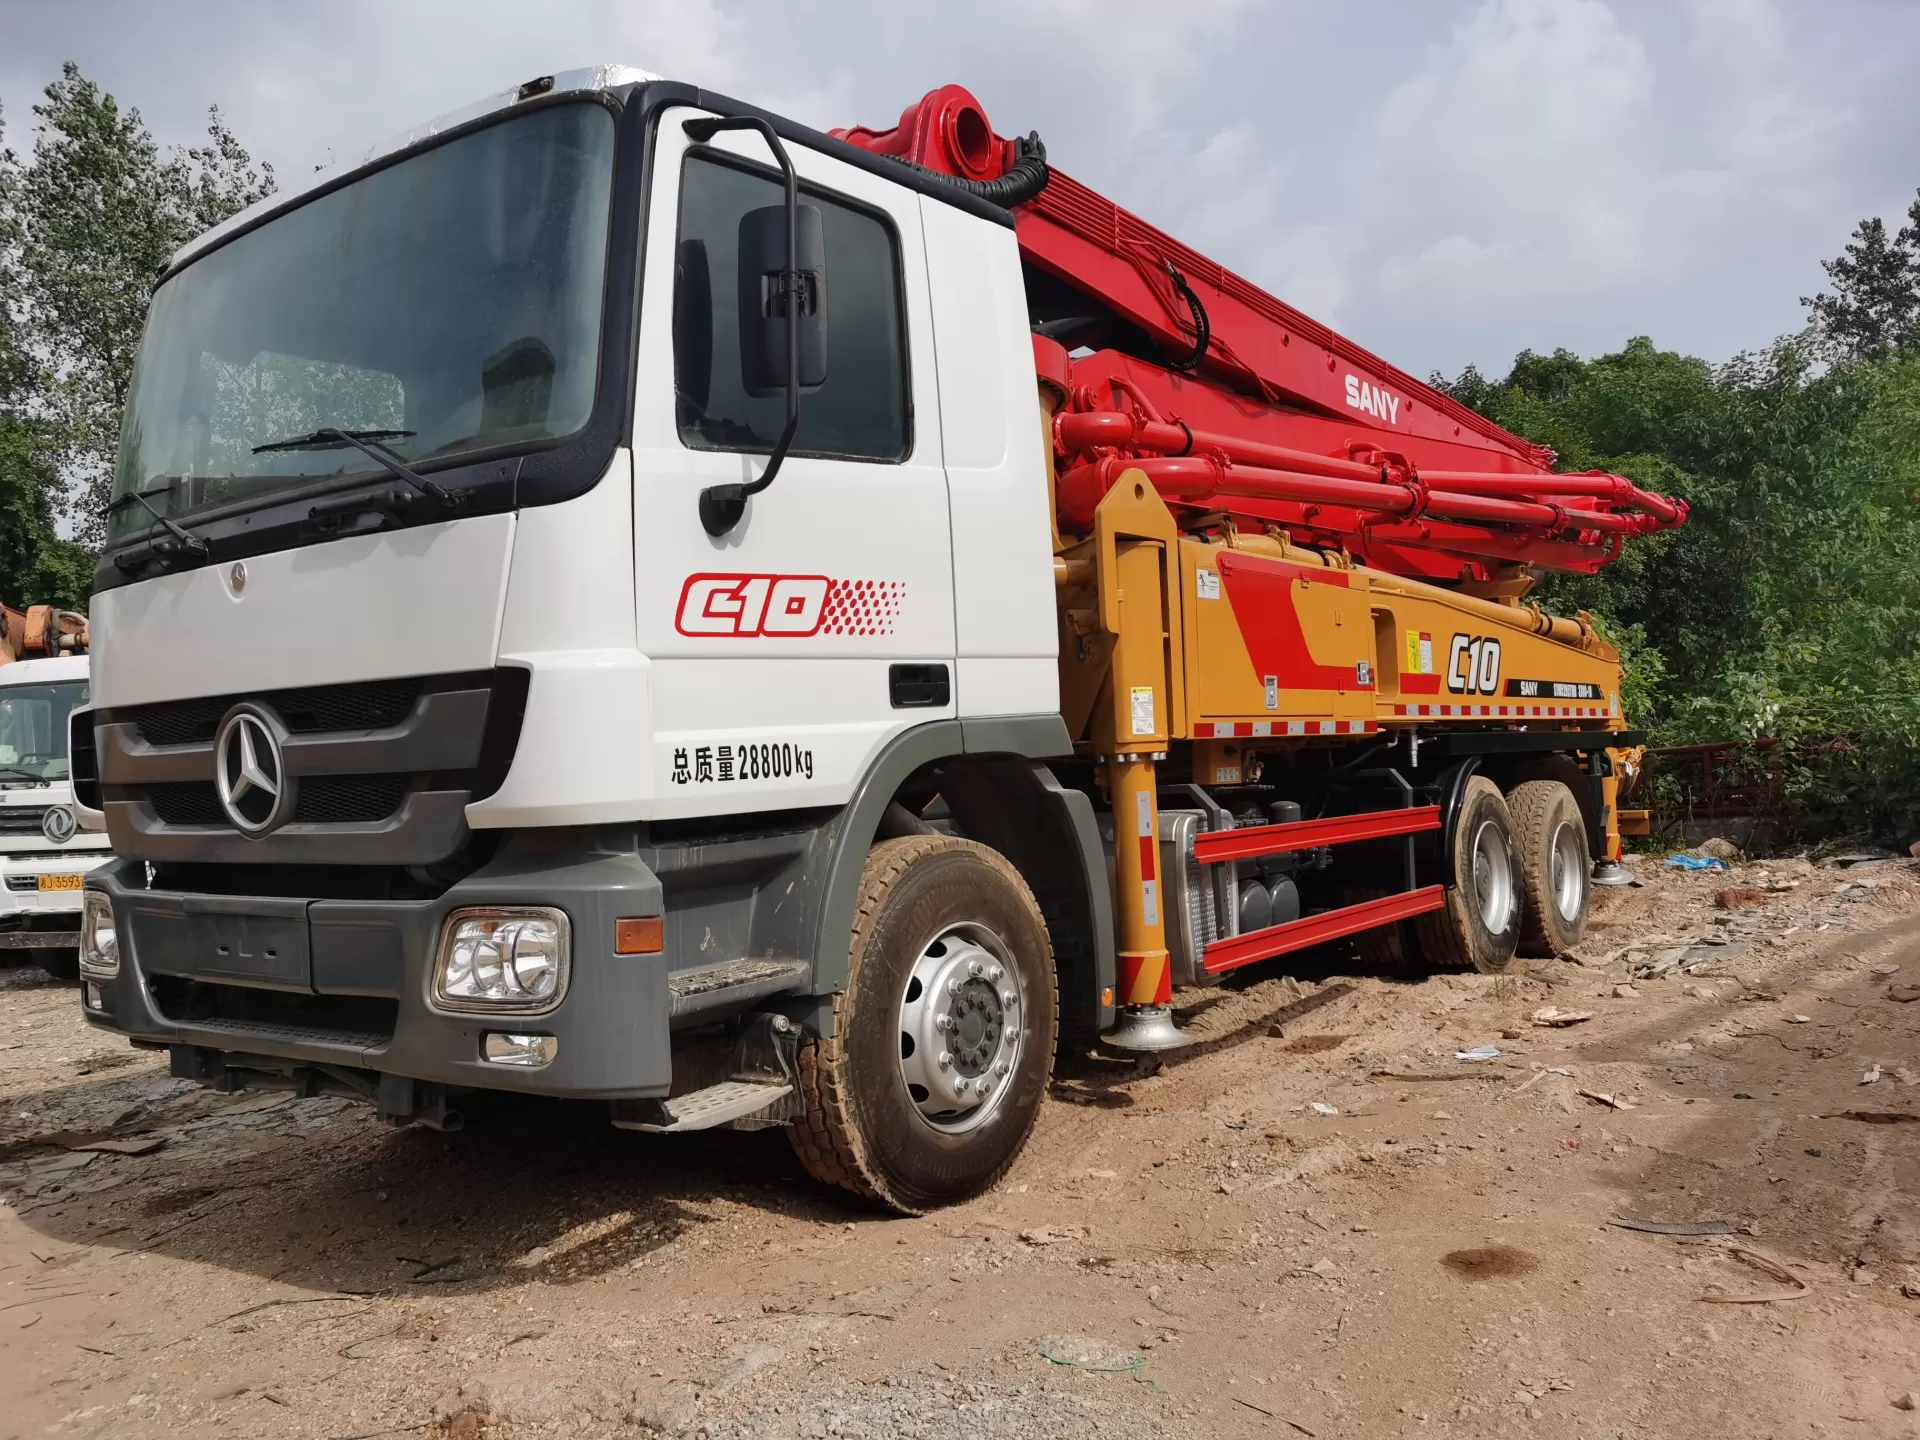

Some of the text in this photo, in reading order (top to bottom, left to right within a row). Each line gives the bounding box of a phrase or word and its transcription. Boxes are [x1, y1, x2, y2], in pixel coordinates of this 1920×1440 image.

[1344, 373, 1400, 425] SANY
[675, 572, 831, 637] C10
[1447, 632, 1501, 696] C10
[1520, 681, 1538, 696] SANY
[671, 742, 813, 785] 总质量28800kg
